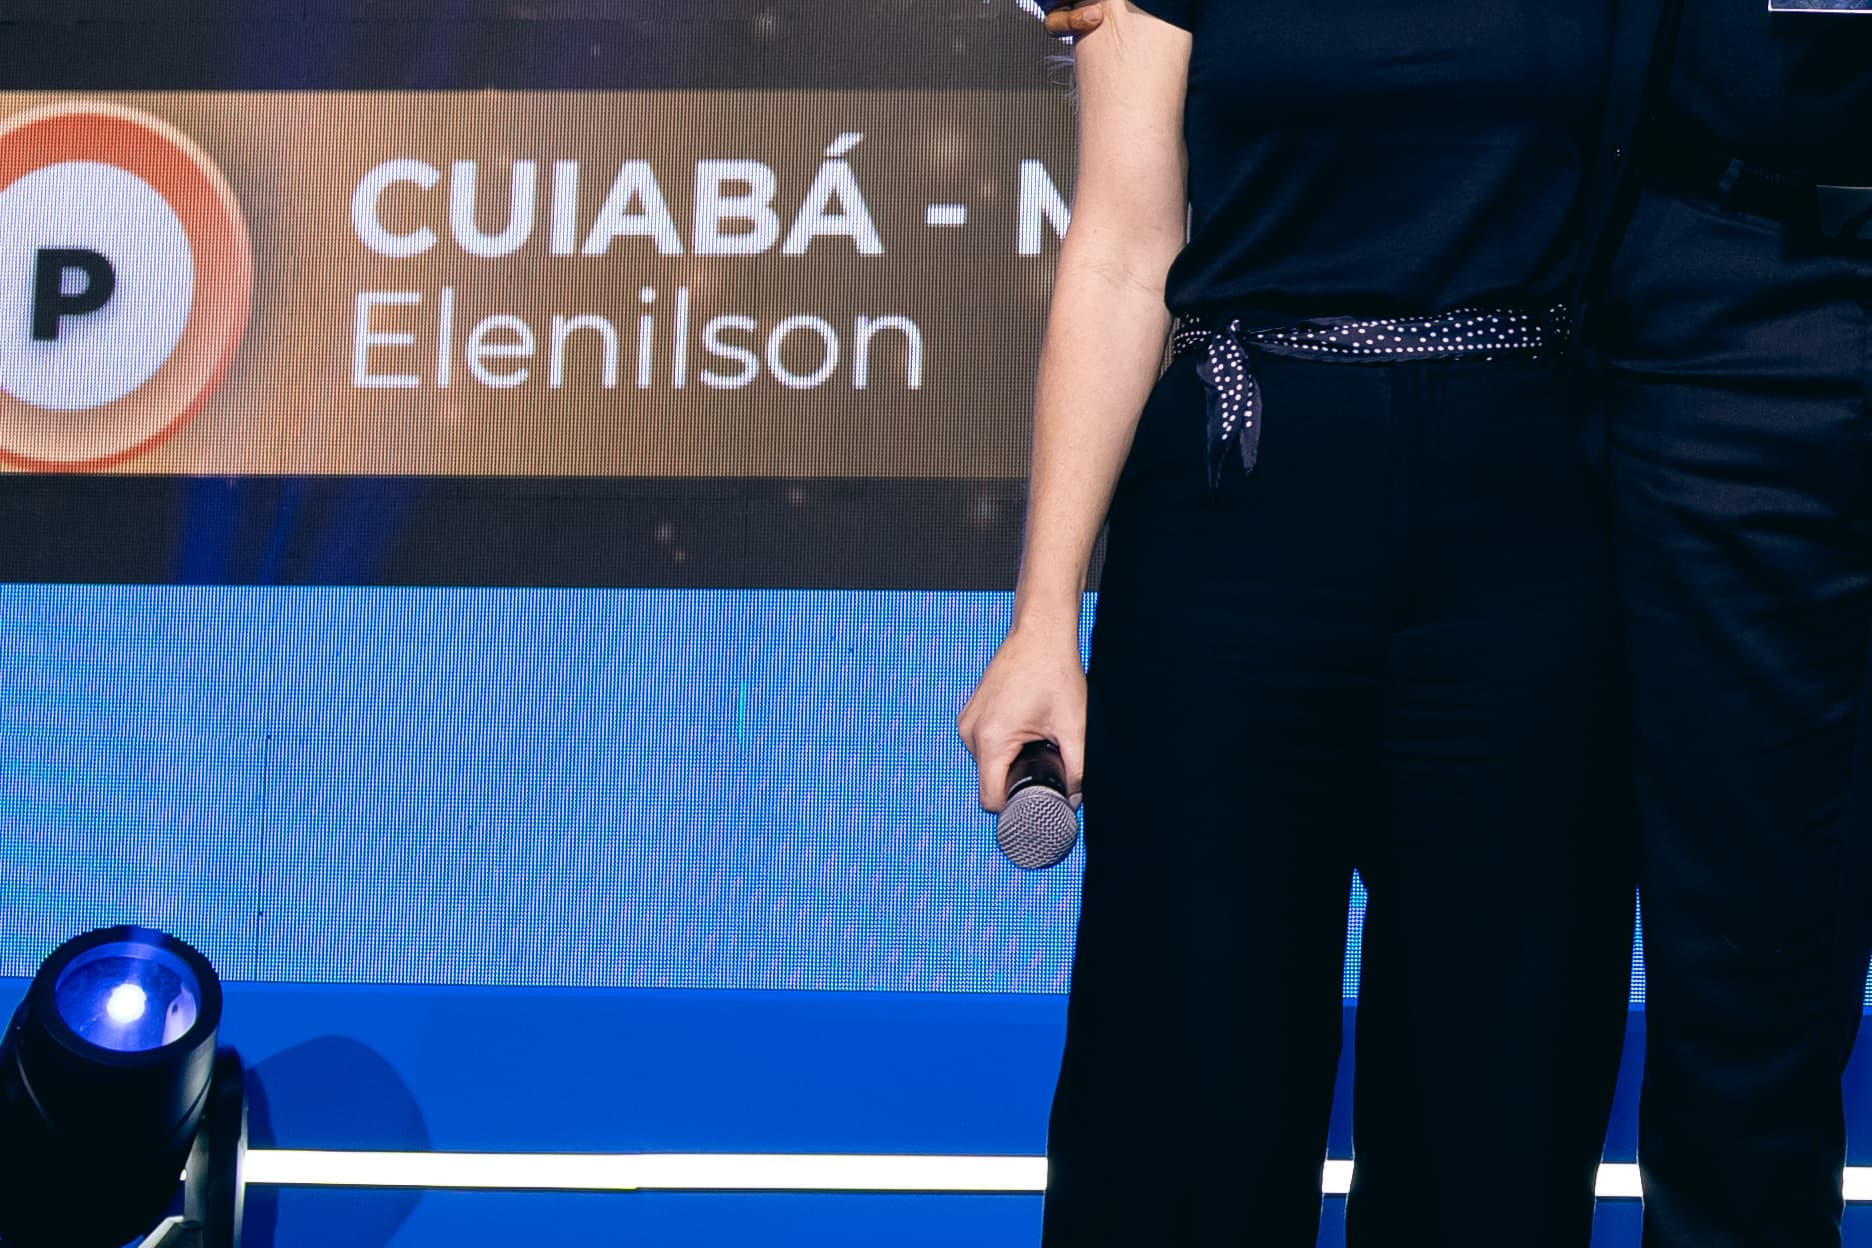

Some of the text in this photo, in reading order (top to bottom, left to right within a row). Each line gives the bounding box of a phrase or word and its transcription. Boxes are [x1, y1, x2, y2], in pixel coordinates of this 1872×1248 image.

[351, 132, 886, 258] CUIABÁ
[30, 247, 117, 342] P
[352, 285, 925, 392] Elenilson
